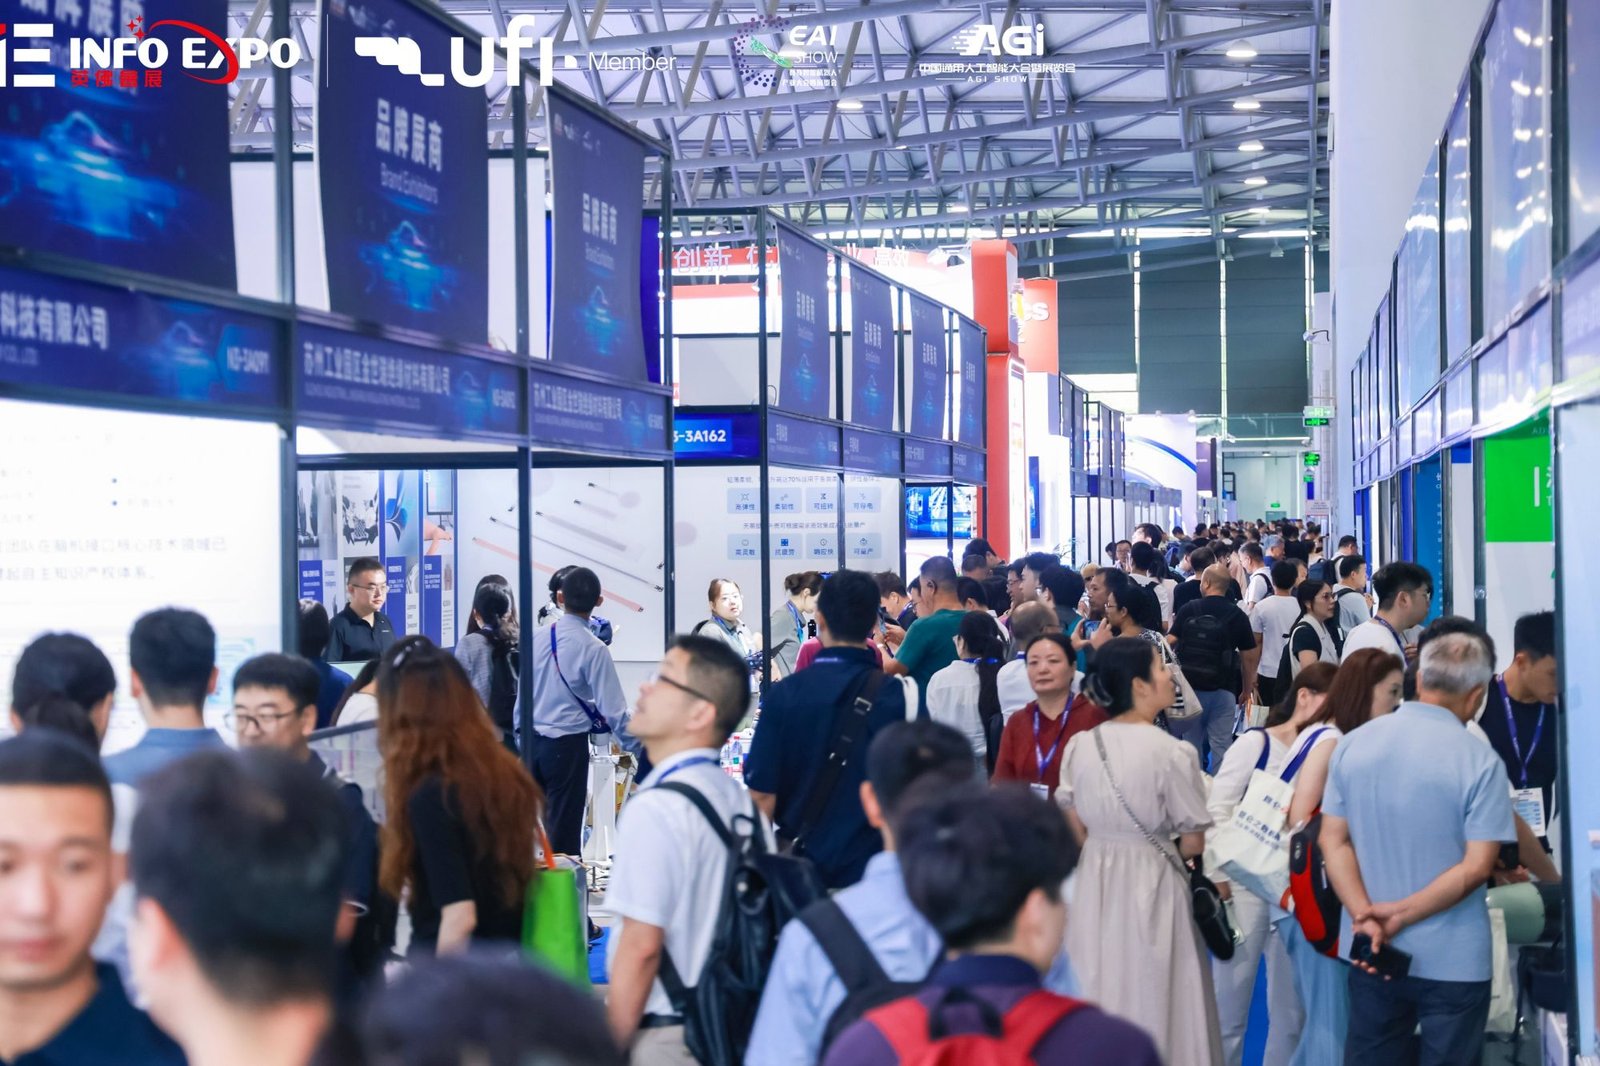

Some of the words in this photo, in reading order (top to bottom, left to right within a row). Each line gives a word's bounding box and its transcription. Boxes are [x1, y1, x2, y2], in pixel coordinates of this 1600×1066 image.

[375, 97, 443, 173] 品牌展商
[674, 245, 733, 272] 创新
